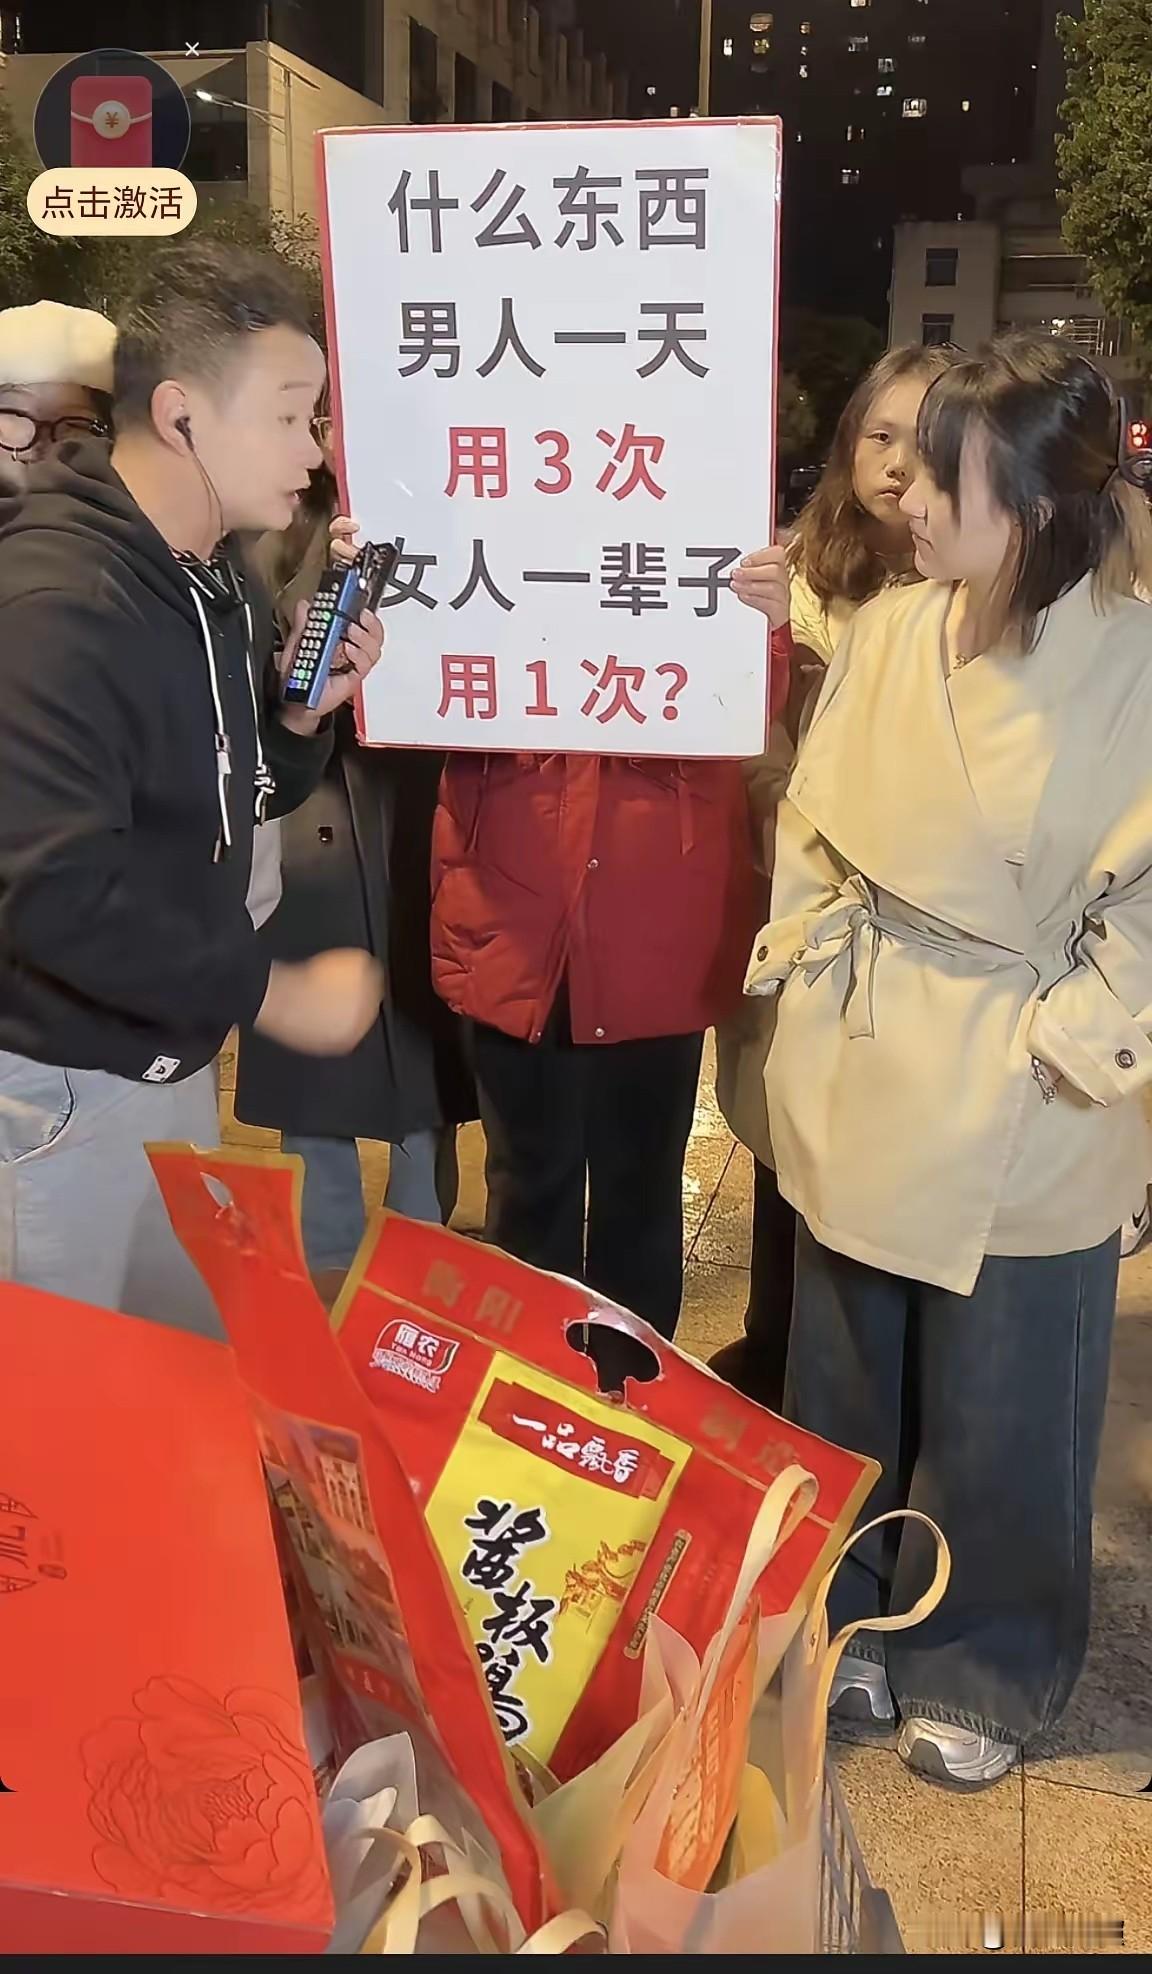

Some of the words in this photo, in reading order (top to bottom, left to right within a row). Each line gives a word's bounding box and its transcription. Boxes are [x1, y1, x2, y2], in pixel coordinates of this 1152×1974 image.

[388, 165, 710, 255] 什么东西
[397, 297, 710, 379] 男人一天
[379, 536, 743, 618] 女人一辈子
